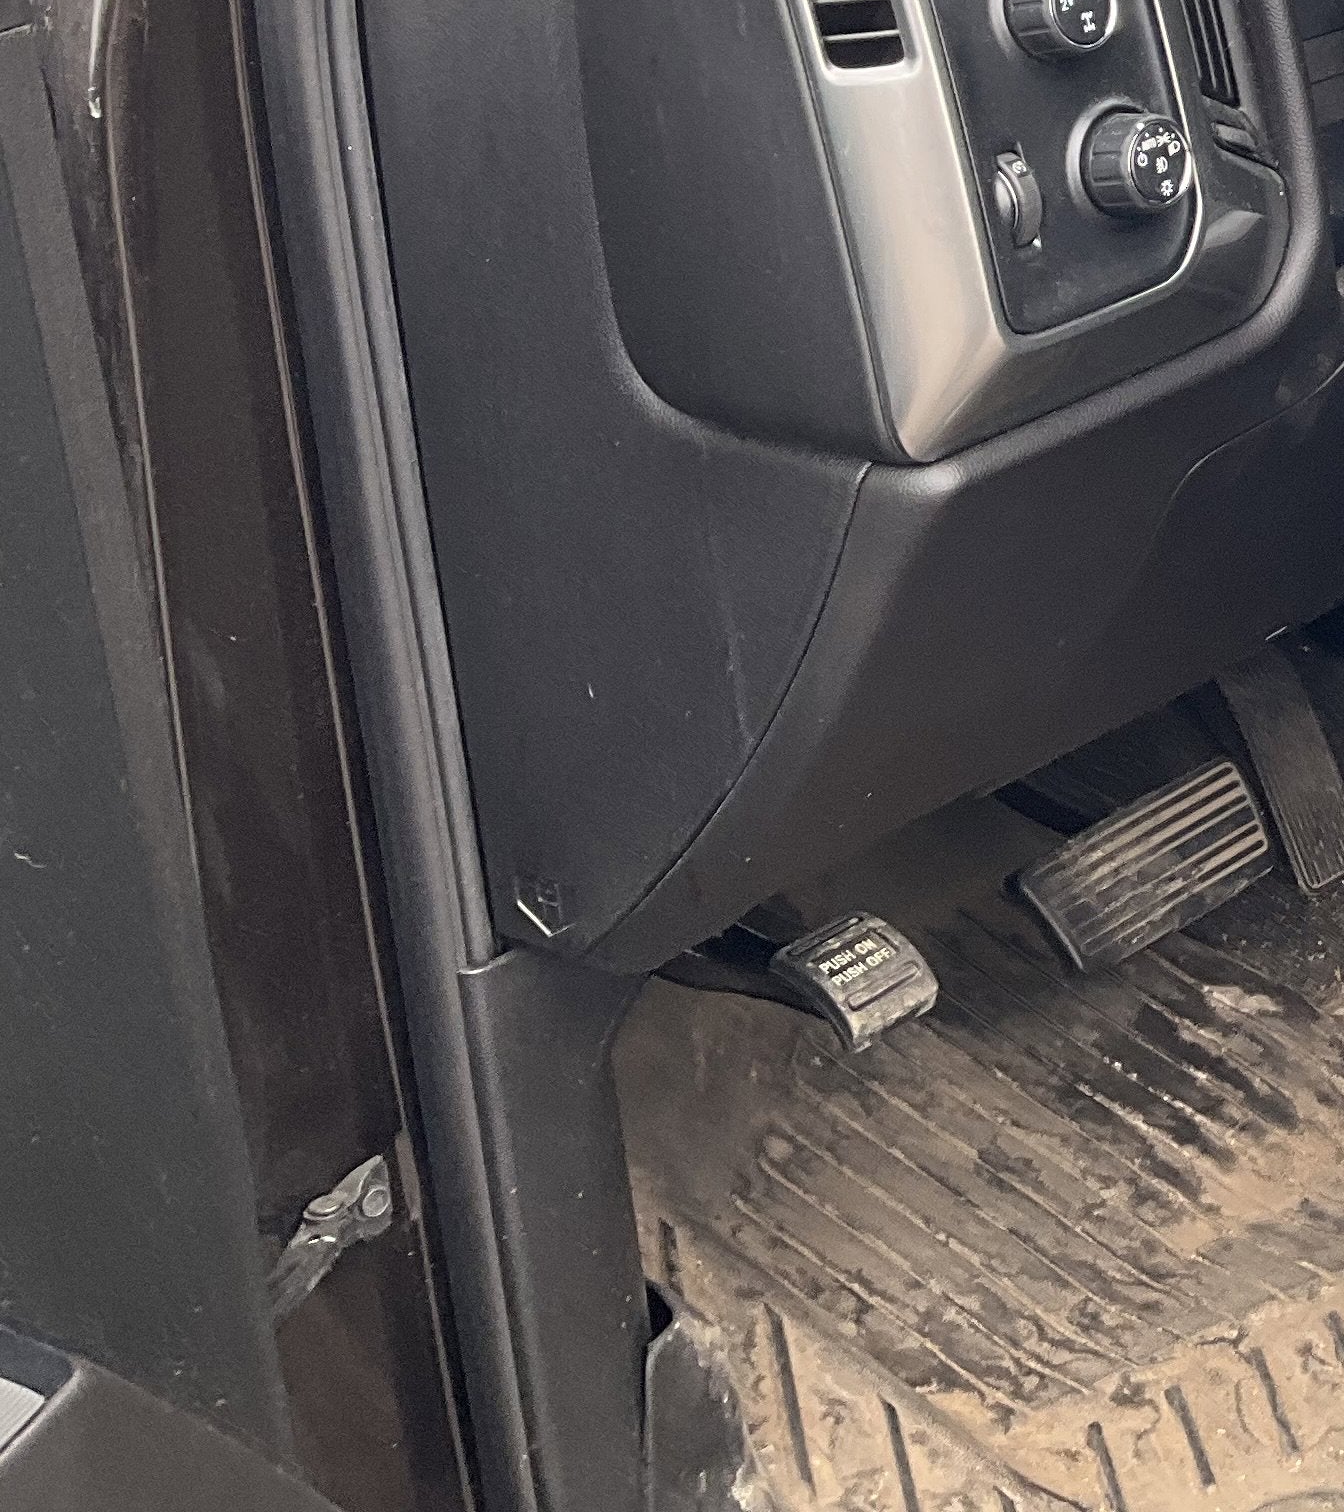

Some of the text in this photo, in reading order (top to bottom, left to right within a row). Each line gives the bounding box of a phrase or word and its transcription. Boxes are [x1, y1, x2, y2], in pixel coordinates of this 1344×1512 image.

[818, 937, 878, 975] PUSH ON
[831, 947, 890, 986] PUSH OFF
